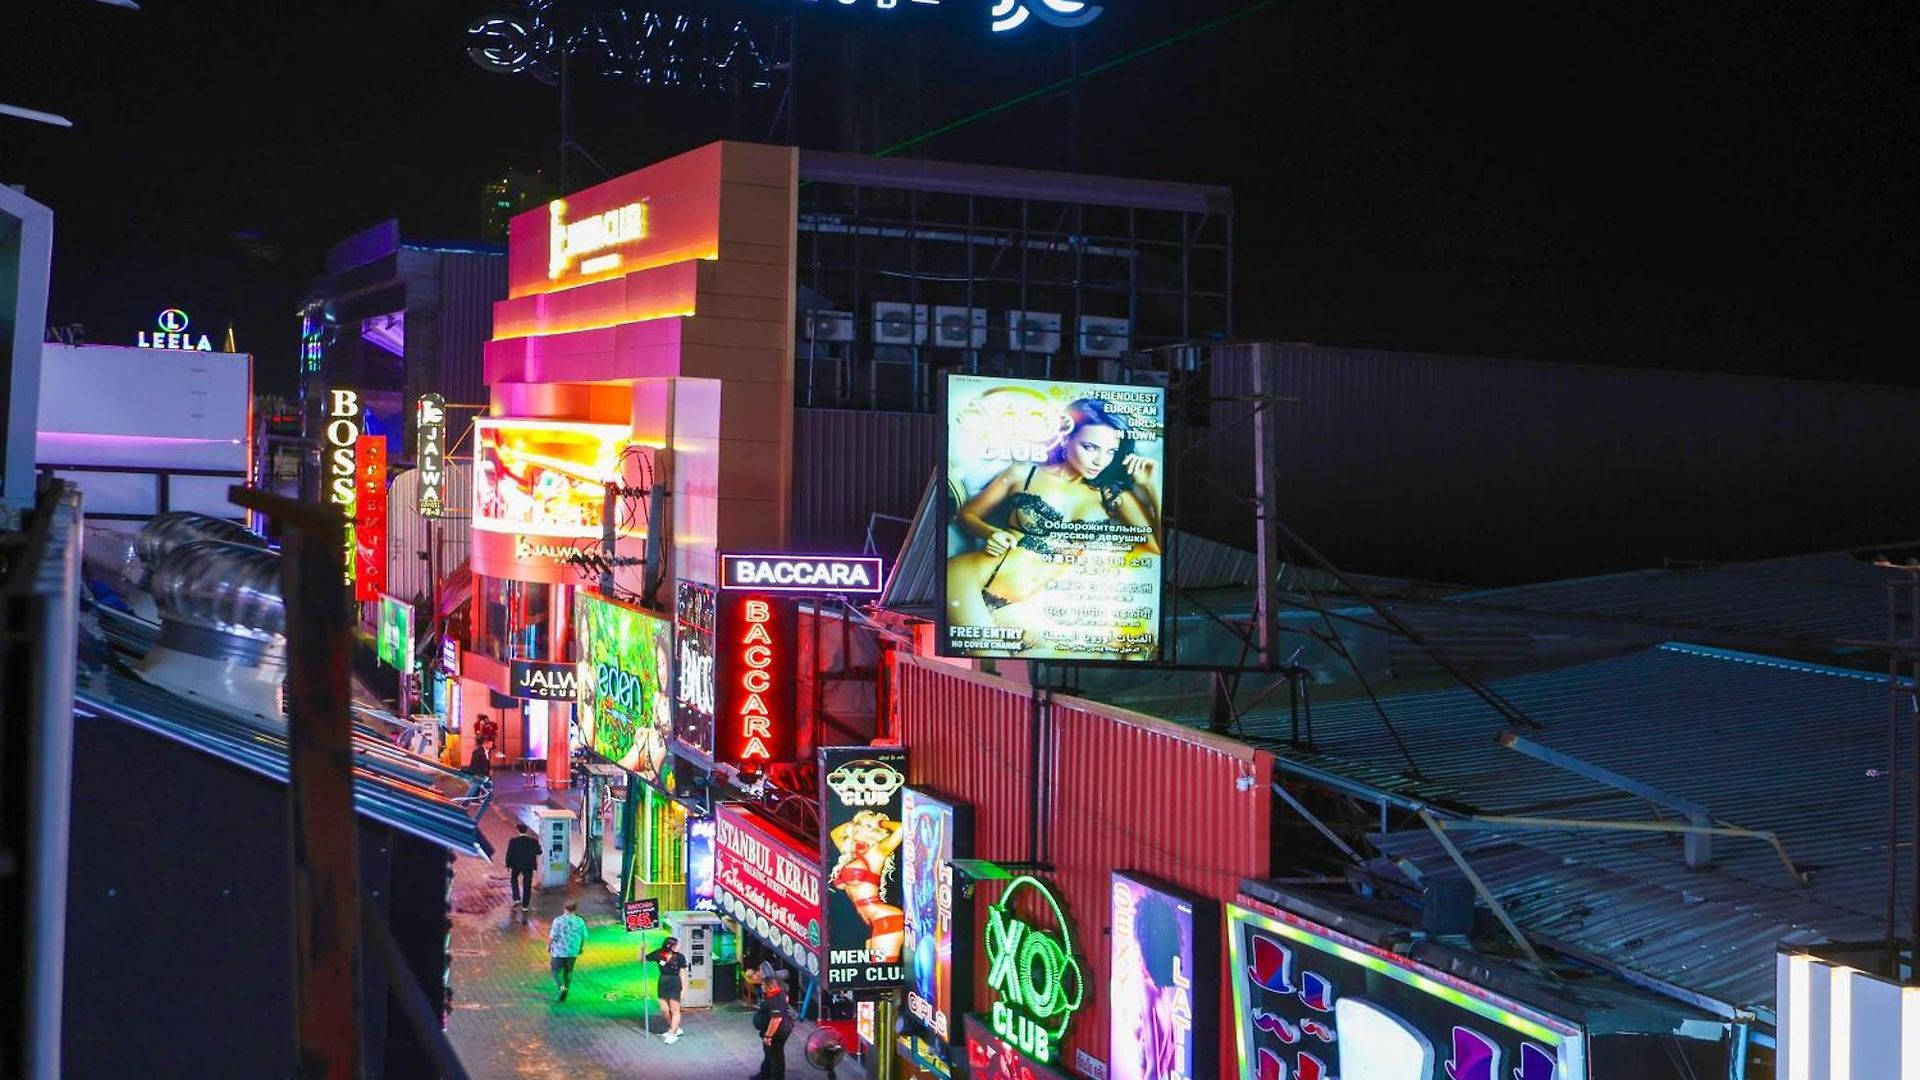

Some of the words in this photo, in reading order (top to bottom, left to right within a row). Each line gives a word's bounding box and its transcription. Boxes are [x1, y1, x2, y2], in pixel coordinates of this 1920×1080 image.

[138, 331, 212, 352] LEELA
[1095, 390, 1157, 403] FRIENDLIEST
[1104, 404, 1157, 415] EUROPEAN
[1128, 417, 1156, 428] GIRLS
[1127, 430, 1156, 441] TOWN
[328, 389, 359, 504] BOSS
[423, 427, 441, 499] JALWA
[1045, 521, 1152, 533] Обворожительные
[1050, 531, 1095, 541] русские
[1098, 533, 1147, 544] девушки
[534, 545, 582, 559] JALWA
[737, 561, 870, 586] BACCARA
[950, 626, 980, 638] FREE
[983, 627, 1024, 640] ENTRY
[952, 640, 963, 648] NO
[964, 641, 989, 649] COVER
[520, 669, 577, 689] JALW
[681, 639, 714, 715] BACC
[741, 601, 771, 760] BACCARA
[539, 688, 576, 698] CLUB
[598, 657, 642, 714] eden
[841, 791, 890, 806] CLUB
[718, 818, 771, 873] ISTANBUL
[776, 854, 820, 906] KEBAB
[939, 859, 953, 932] HOT
[830, 949, 888, 965] MEN'S
[988, 905, 1061, 1018] XO
[829, 968, 858, 983] RIP
[866, 967, 904, 981] CLU
[993, 1001, 1049, 1063] CLUB
